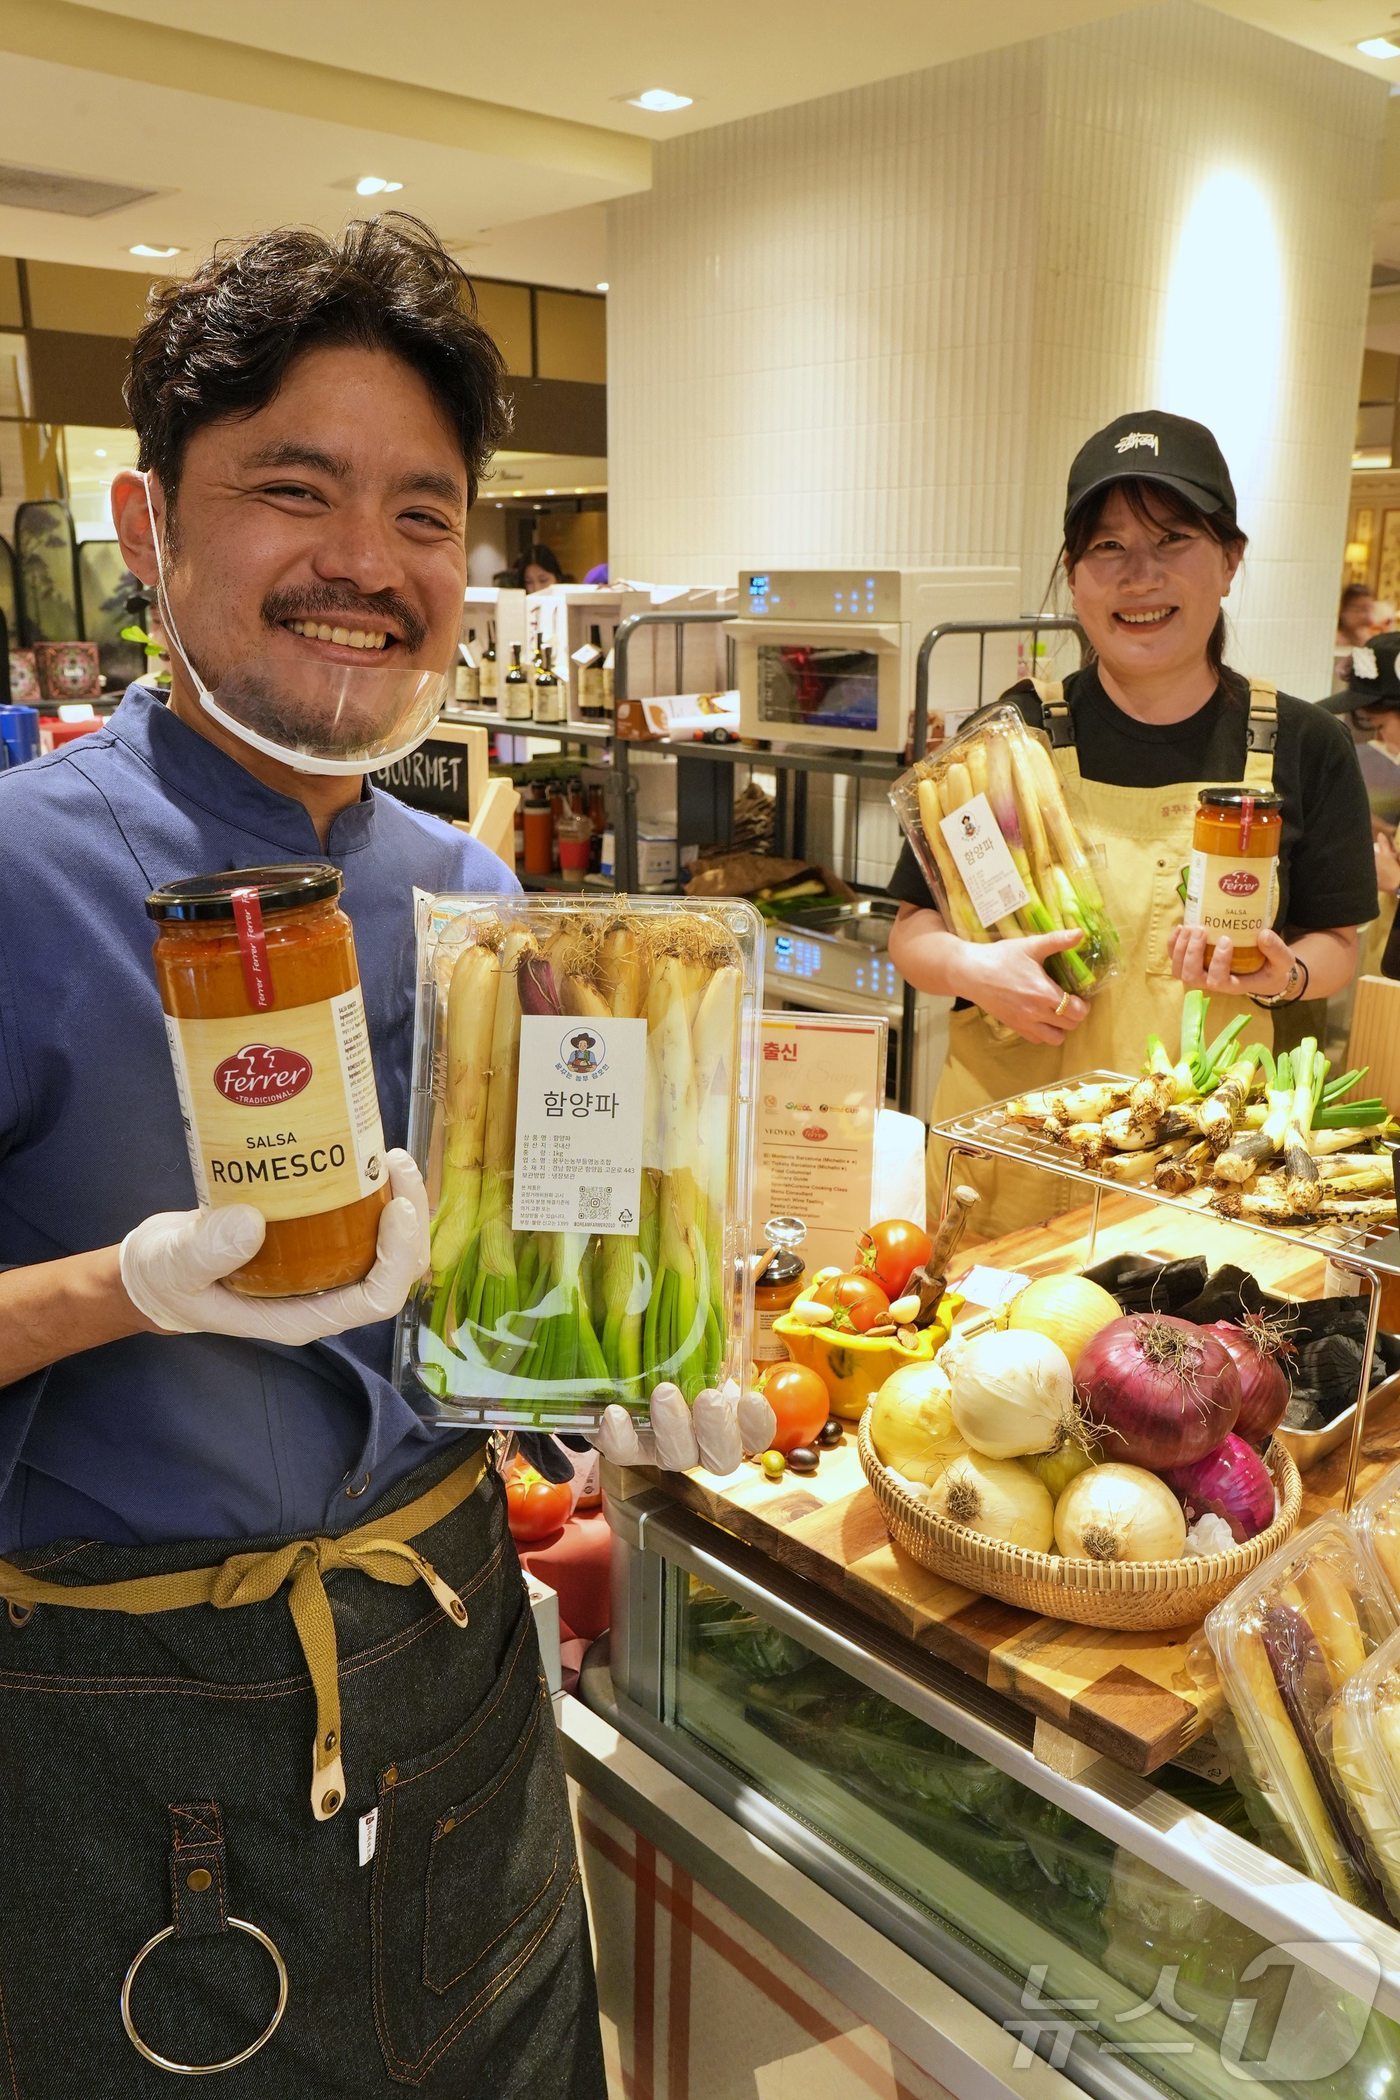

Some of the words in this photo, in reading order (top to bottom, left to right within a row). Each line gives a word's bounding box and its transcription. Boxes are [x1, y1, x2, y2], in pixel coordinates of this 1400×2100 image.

[964, 836, 995, 866] 함양파
[1222, 878, 1259, 891] Ferrer
[244, 908, 256, 939] Ferrer
[1204, 915, 1263, 930] ROMESCO
[250, 942, 262, 972] Ferrer
[256, 976, 267, 1007] Ferrer
[763, 1042, 797, 1062] 출신
[223, 1066, 306, 1094] Ferrer
[238, 1089, 293, 1105] TRADICIONAL
[543, 1090, 620, 1119] 함양파
[246, 1131, 298, 1149] SALSA
[211, 1144, 346, 1184] ROMESCO
